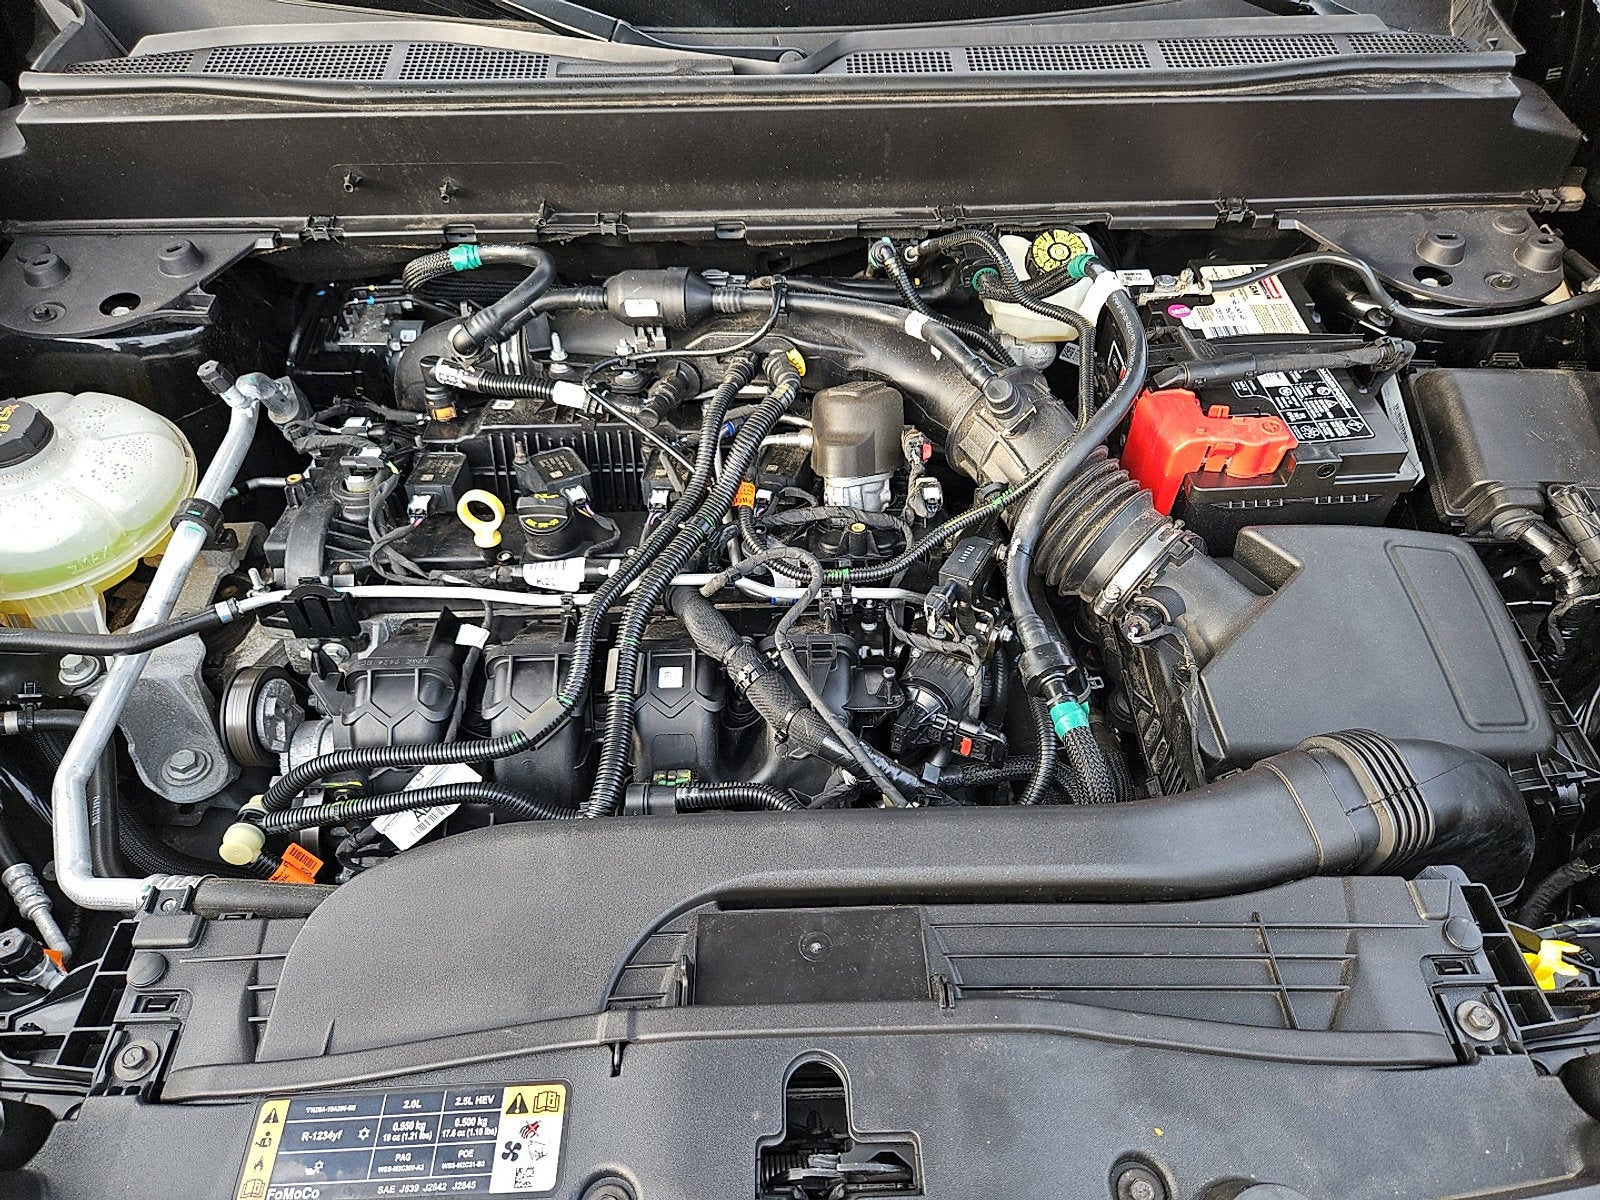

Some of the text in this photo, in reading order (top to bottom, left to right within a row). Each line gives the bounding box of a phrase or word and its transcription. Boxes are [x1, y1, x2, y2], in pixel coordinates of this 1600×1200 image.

[402, 1099, 422, 1109] 2.0L
[474, 1094, 496, 1105] HEV
[415, 1120, 427, 1131] kg
[476, 1116, 488, 1128] kg
[301, 1129, 344, 1142] R-1234yf
[395, 1153, 412, 1162] PAG
[457, 1149, 475, 1159] POE
[266, 1185, 321, 1200] FoMoCo
[377, 1185, 396, 1195] SAE
[398, 1183, 420, 1193] J639
